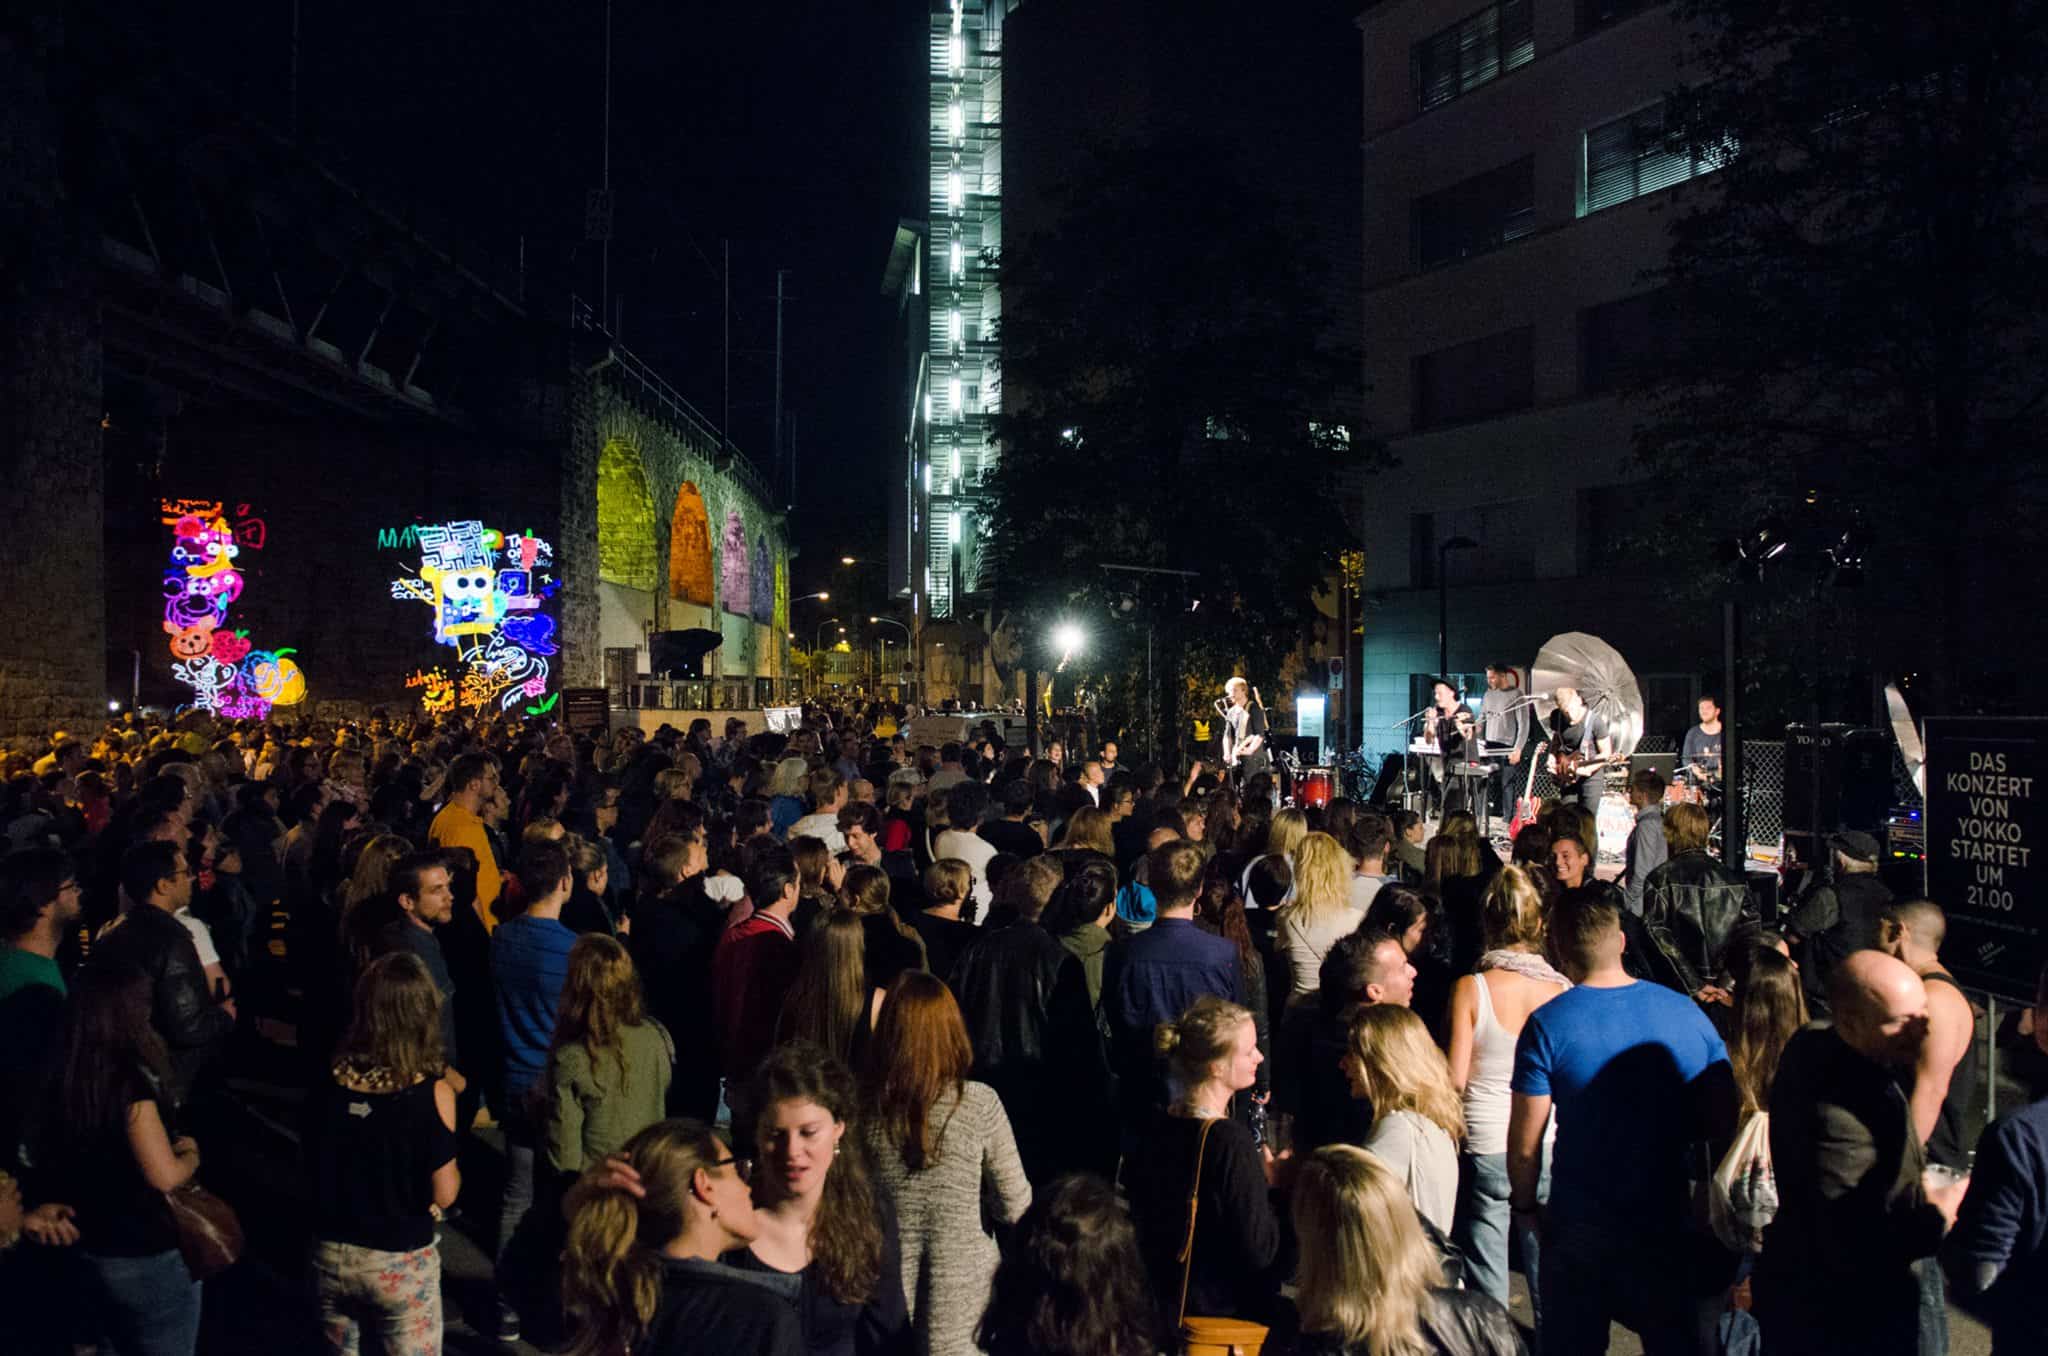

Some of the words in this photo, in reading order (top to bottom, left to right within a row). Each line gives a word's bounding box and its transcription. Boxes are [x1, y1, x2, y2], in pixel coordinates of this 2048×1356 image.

[1970, 752, 2006, 772] DAS
[1947, 773, 2033, 798] KONZERT
[1969, 796, 2009, 819] VON
[1958, 817, 2022, 843] YOKKO
[1951, 839, 2031, 868] STARTET
[1976, 863, 2003, 887] UM
[1967, 885, 2014, 912] 21.00
